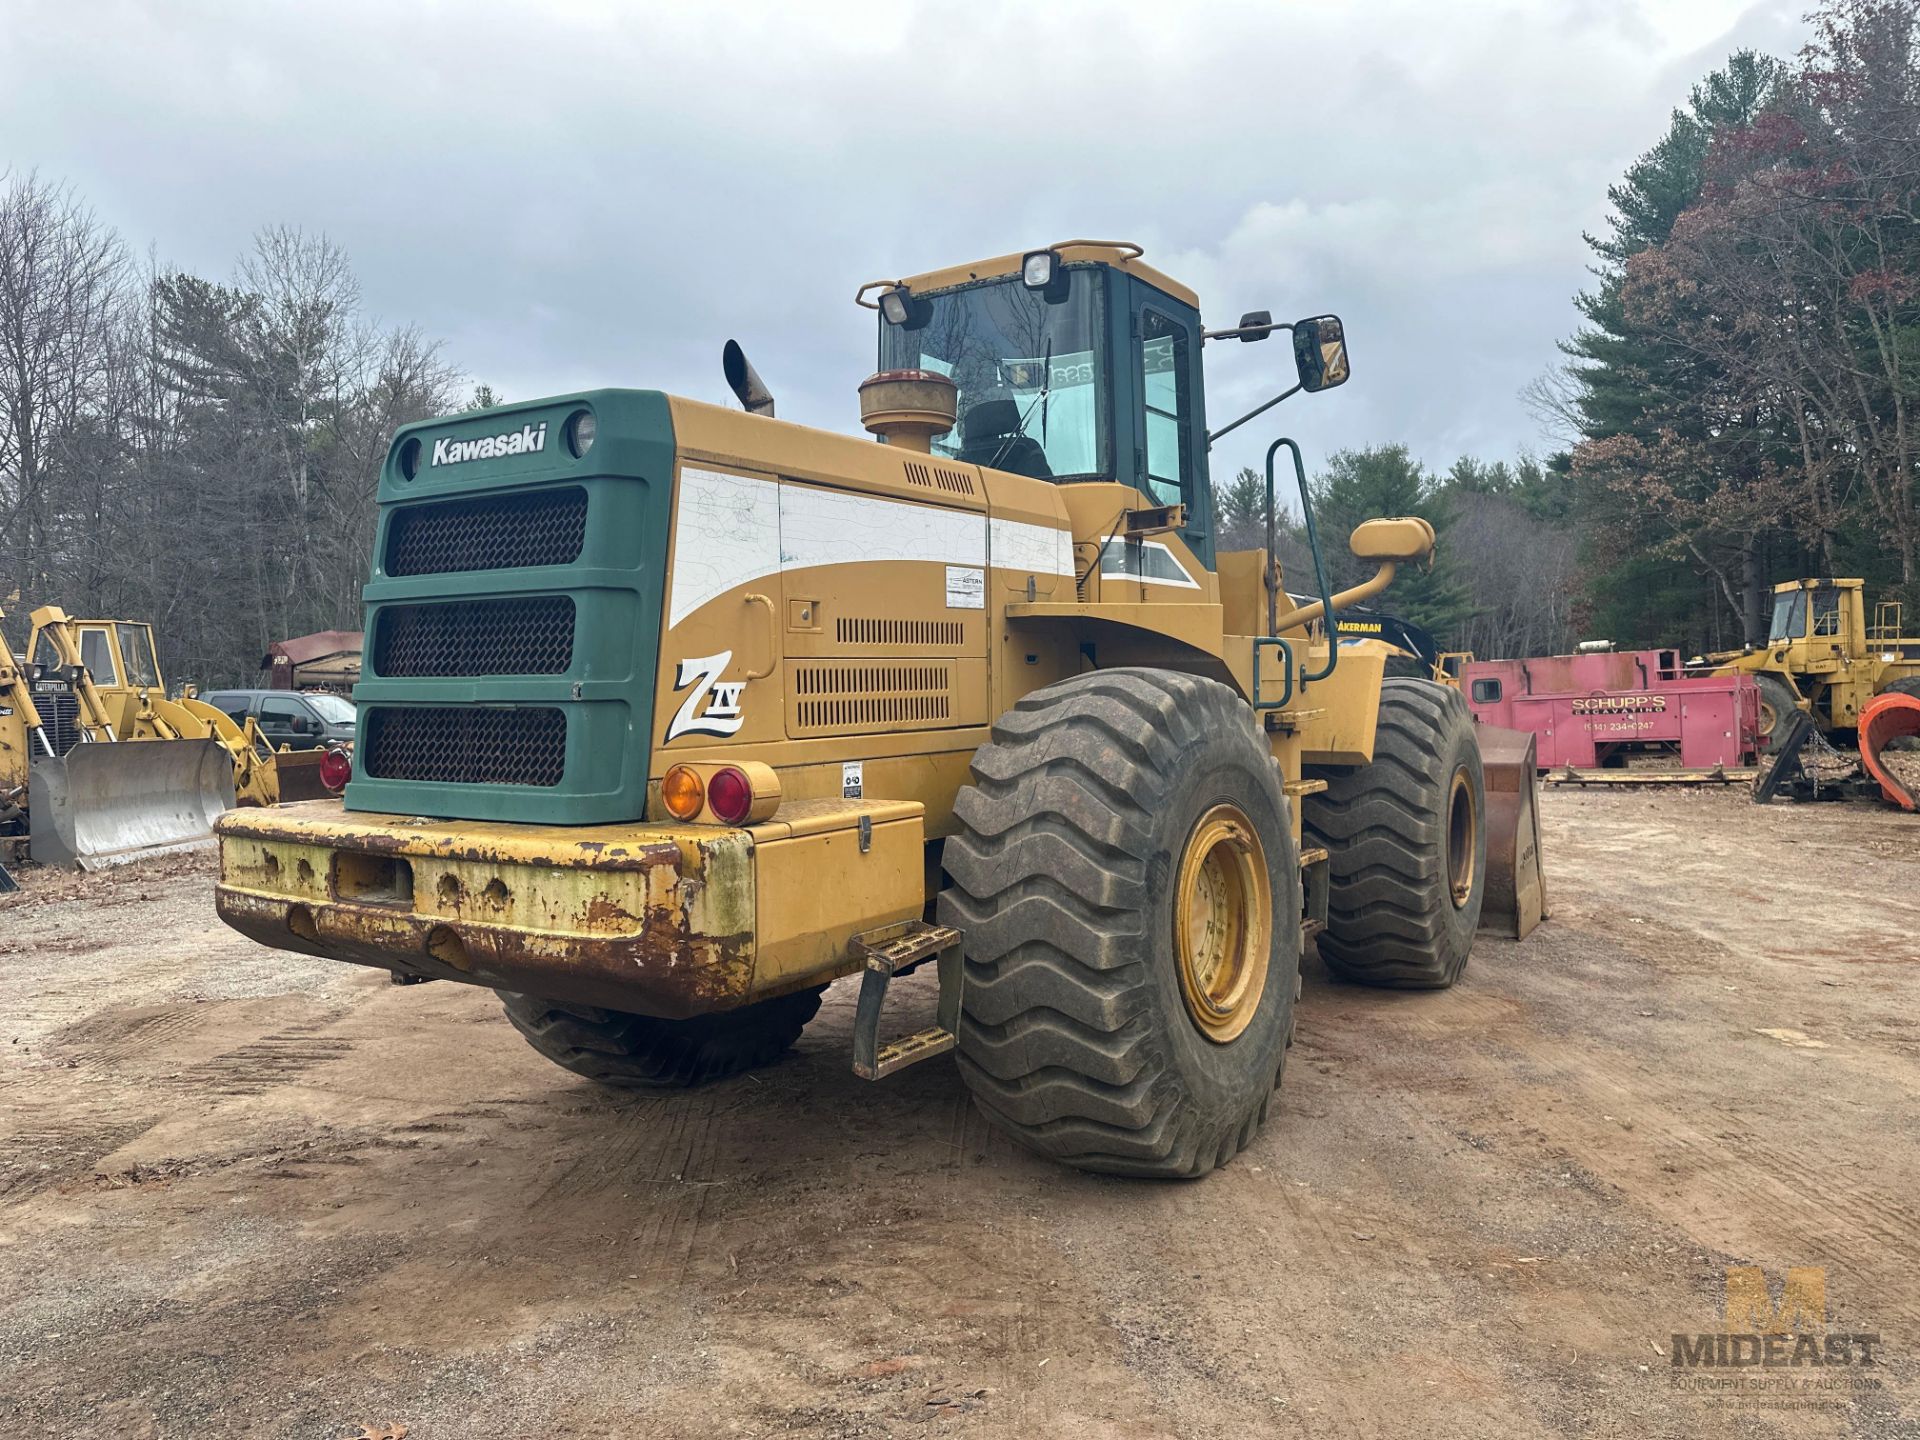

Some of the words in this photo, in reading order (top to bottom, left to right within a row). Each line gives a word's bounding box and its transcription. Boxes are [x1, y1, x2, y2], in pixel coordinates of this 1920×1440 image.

[431, 422, 548, 467] Kawasaki
[35, 683, 68, 691] CATERPILLAR
[1572, 696, 1666, 709] SCHUPP'S
